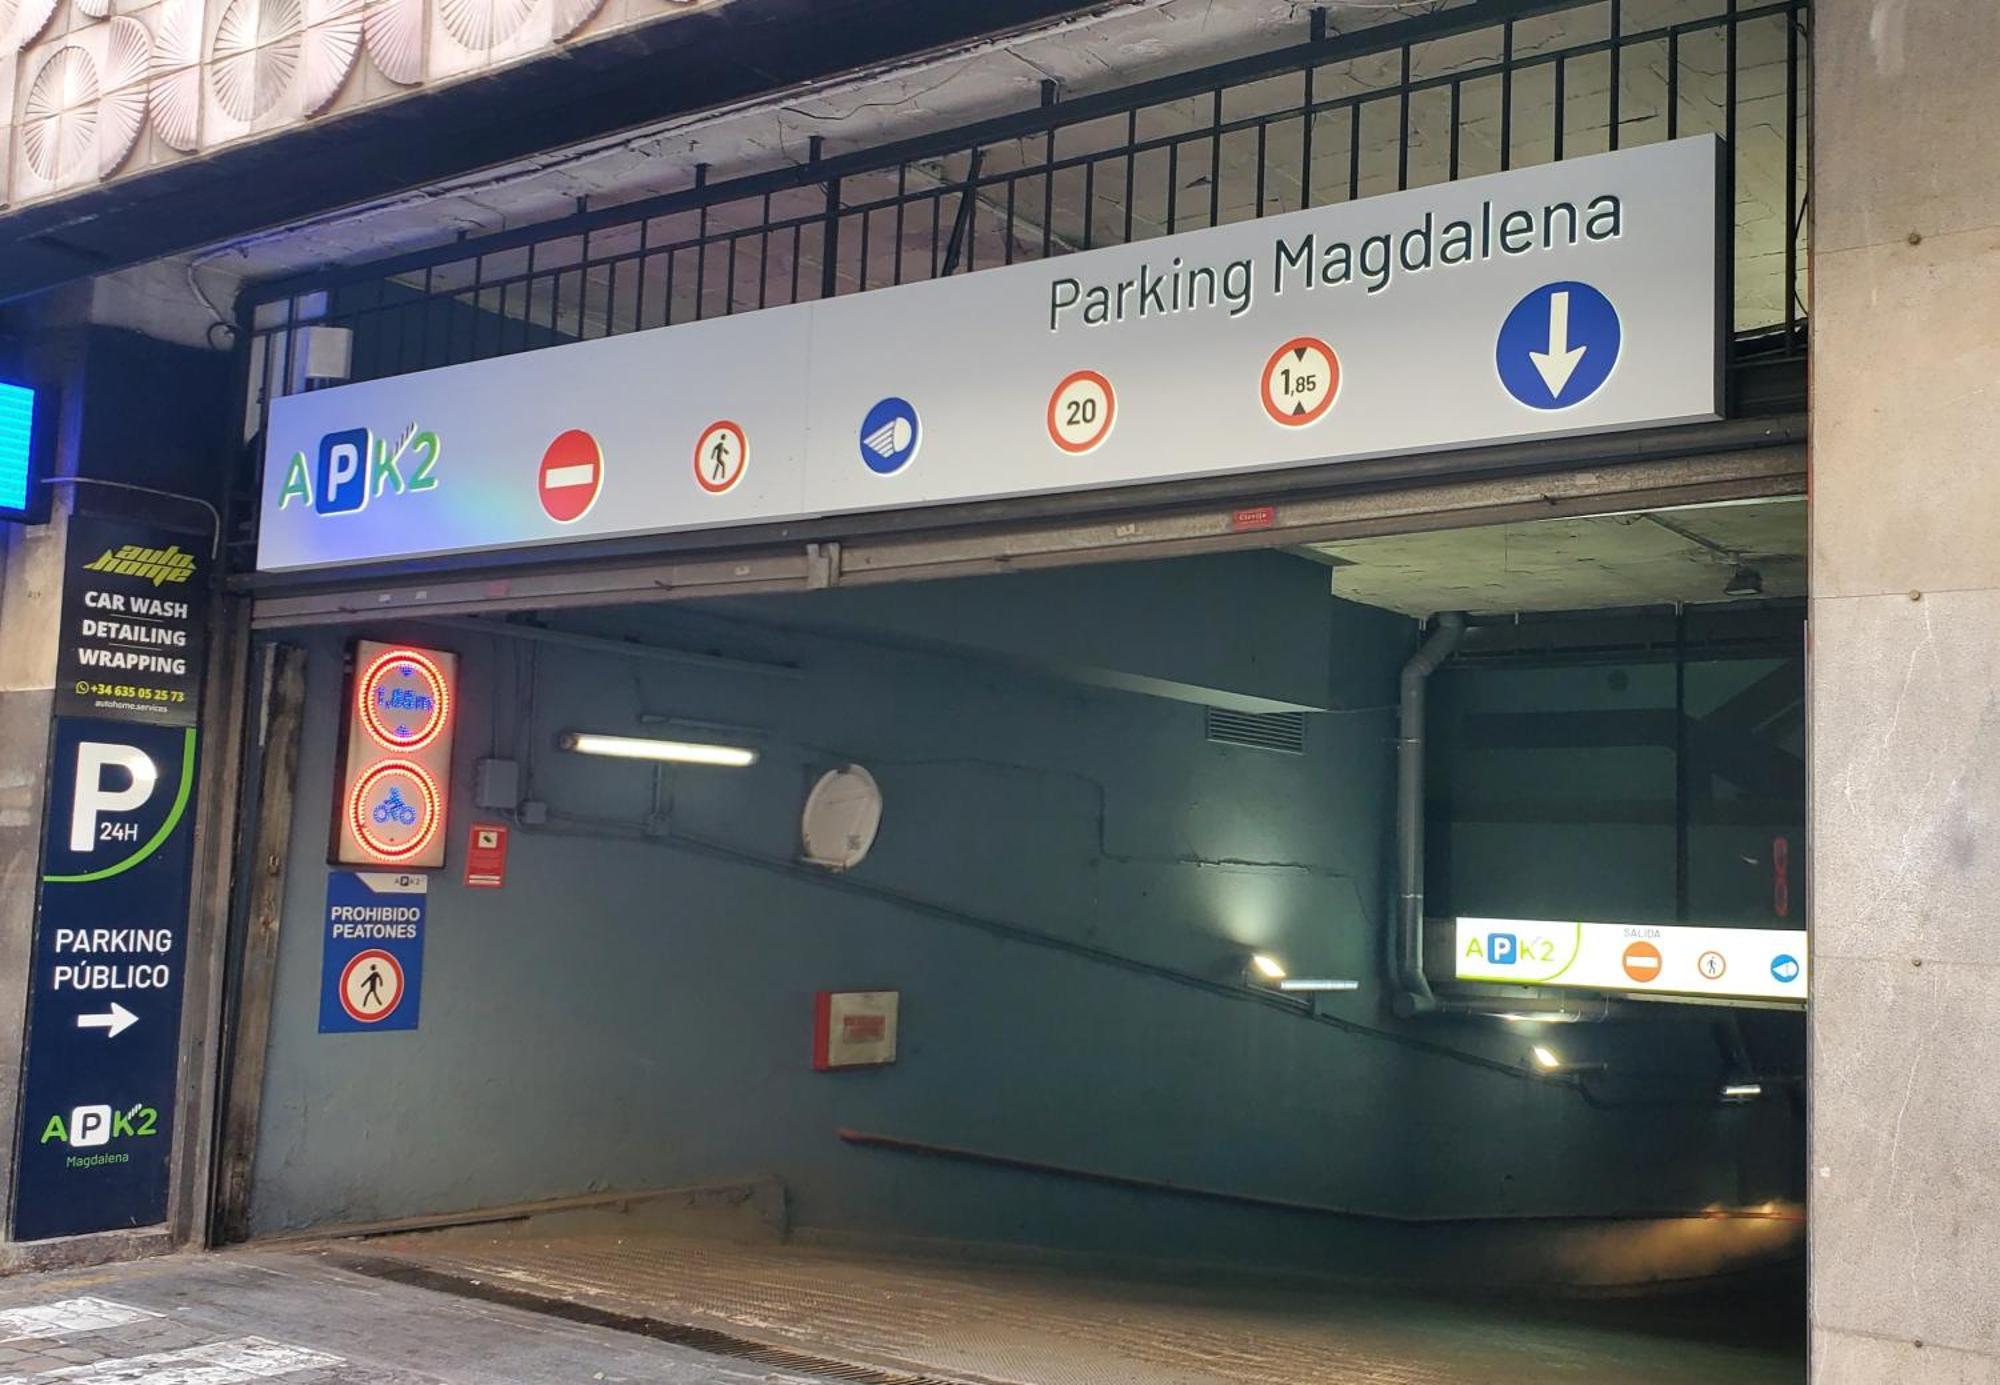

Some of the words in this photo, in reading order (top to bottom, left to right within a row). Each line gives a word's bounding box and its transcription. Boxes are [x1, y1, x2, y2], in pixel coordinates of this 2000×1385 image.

[1049, 257, 1254, 331] Parking
[1273, 192, 1623, 294] Magdalena
[1280, 368, 1316, 397] 1,85
[1066, 398, 1097, 426] 20
[278, 422, 441, 516] APK2
[84, 591, 126, 612] CAR
[130, 597, 188, 619] WASH
[82, 619, 187, 647] DETAILING
[78, 648, 187, 675] WRAPPING
[90, 683, 113, 696] +34
[114, 685, 136, 698] 635
[138, 687, 152, 700] 05
[154, 689, 169, 701] 25
[170, 691, 185, 703] 73
[70, 741, 158, 852] P
[100, 822, 138, 842] 24H
[331, 906, 421, 922] PROHIBIDO
[55, 929, 173, 954] PARKING
[332, 924, 417, 939] PEATONES
[1623, 927, 1662, 938] SALIDA
[1465, 933, 1555, 965] APK2
[53, 960, 170, 990] PÚBLICO
[40, 1103, 158, 1147] APK2
[66, 1153, 129, 1169] Magdalena
